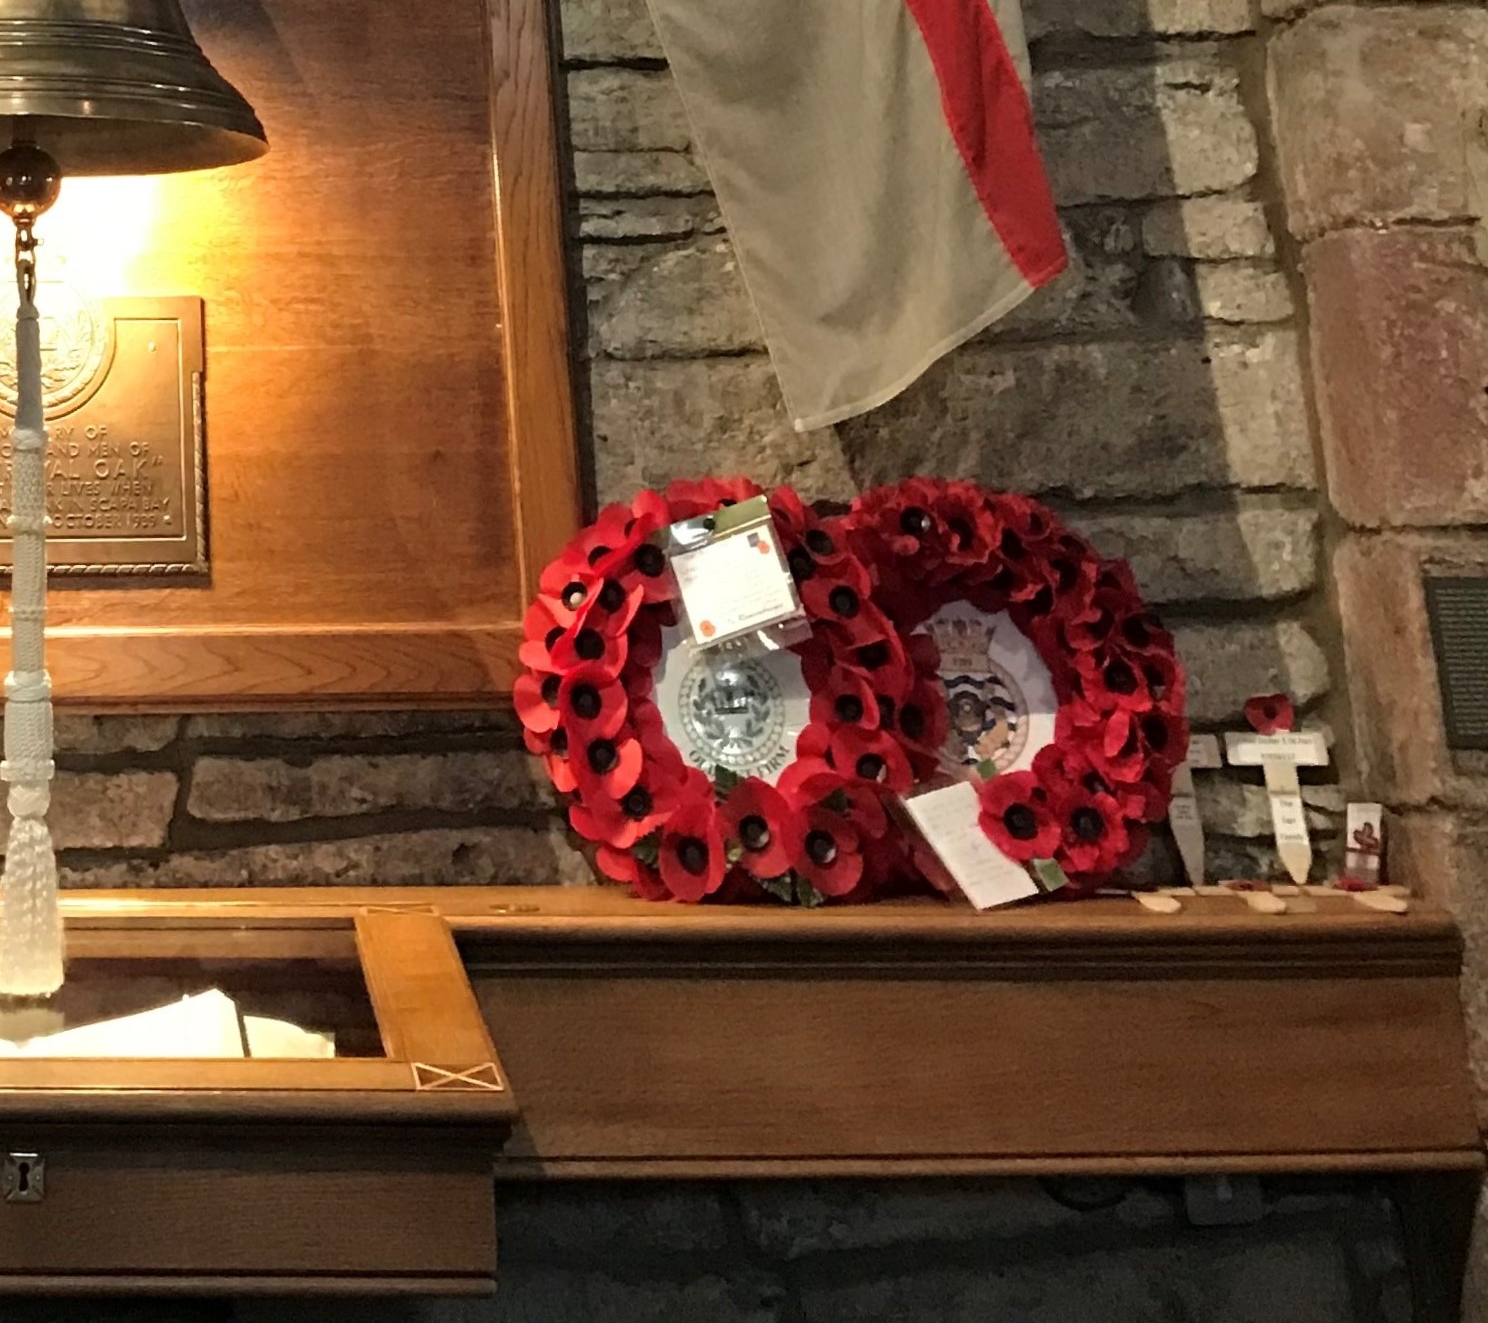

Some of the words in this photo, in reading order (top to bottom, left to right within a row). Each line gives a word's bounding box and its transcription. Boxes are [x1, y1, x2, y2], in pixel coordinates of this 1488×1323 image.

[85, 424, 108, 440] OF
[87, 441, 121, 458] MEN
[129, 441, 150, 458] OF
[61, 481, 101, 497] LIVES
[111, 481, 153, 497] WHEN
[89, 497, 137, 513] SCAPA
[142, 497, 170, 513] BAY
[53, 513, 122, 529] OCTOBER
[125, 512, 156, 529] 1939
[757, 746, 790, 777] FIRM
